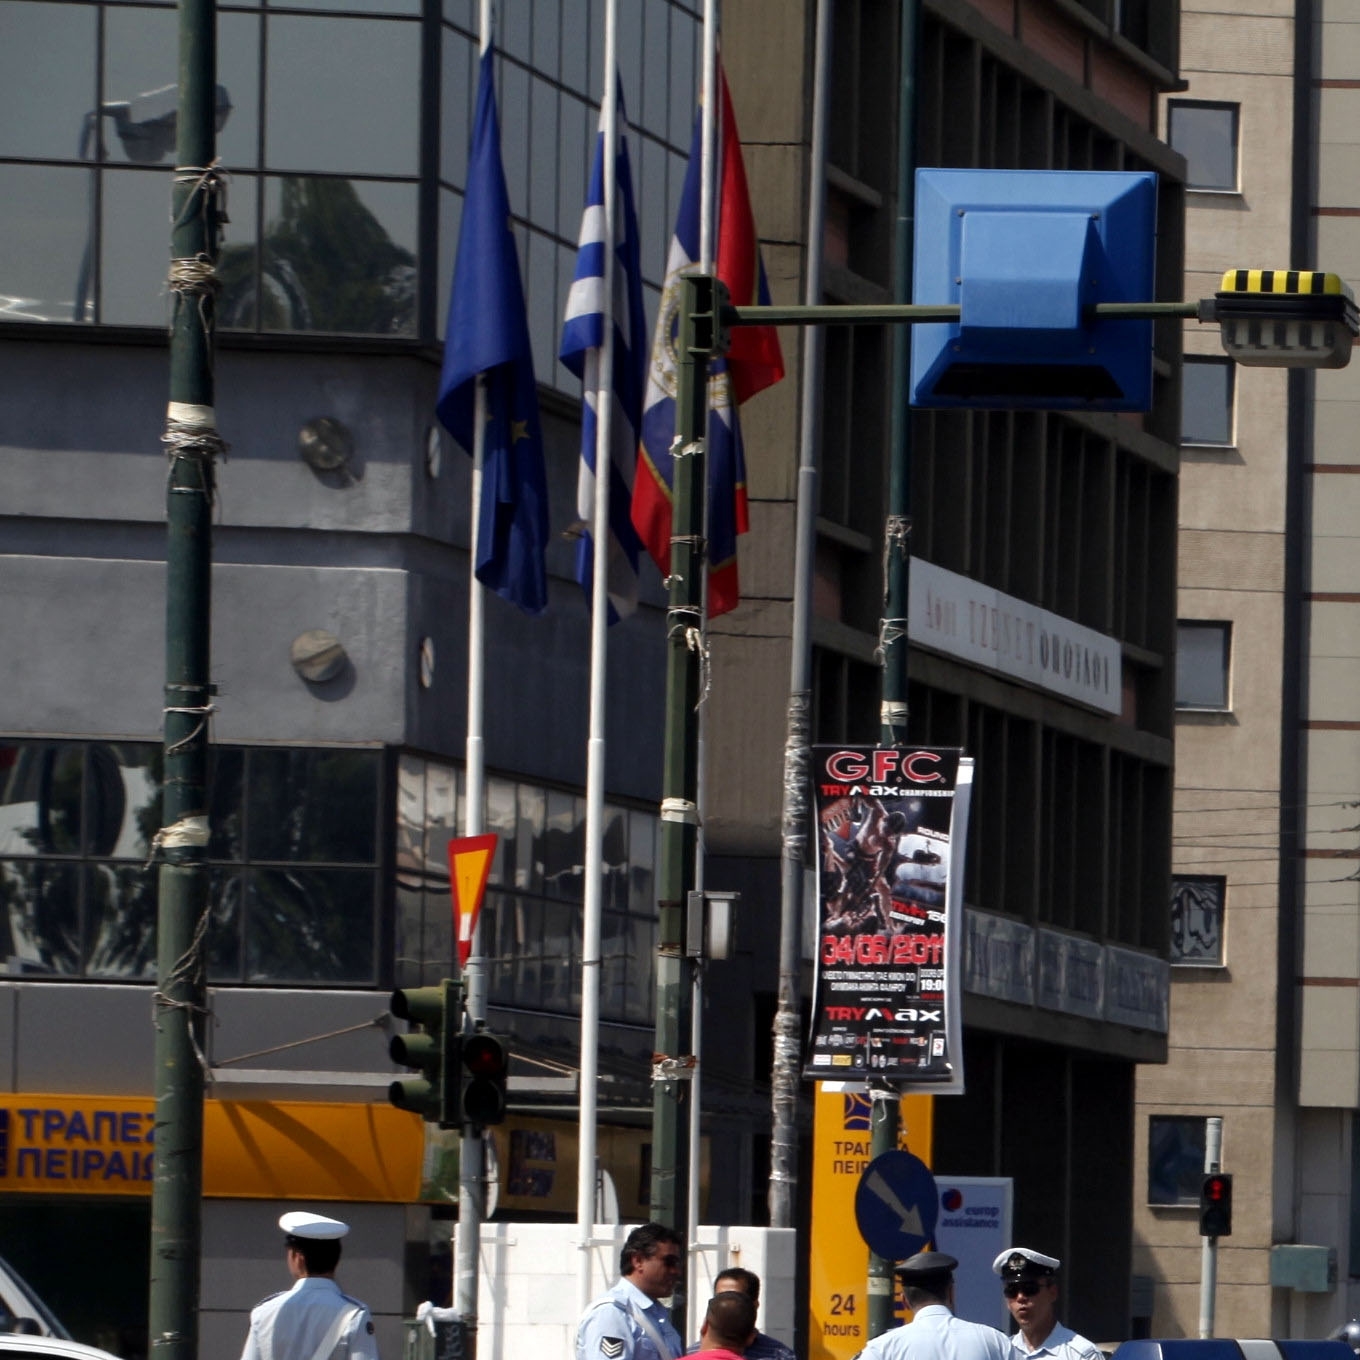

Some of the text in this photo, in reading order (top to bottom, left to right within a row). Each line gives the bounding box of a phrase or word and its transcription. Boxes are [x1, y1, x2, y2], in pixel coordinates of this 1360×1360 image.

[826, 751, 946, 783] G.F.C.
[964, 1206, 999, 1217] europ
[942, 1218, 999, 1228] assistance
[830, 1294, 855, 1316] 24
[823, 1321, 860, 1337] hours
